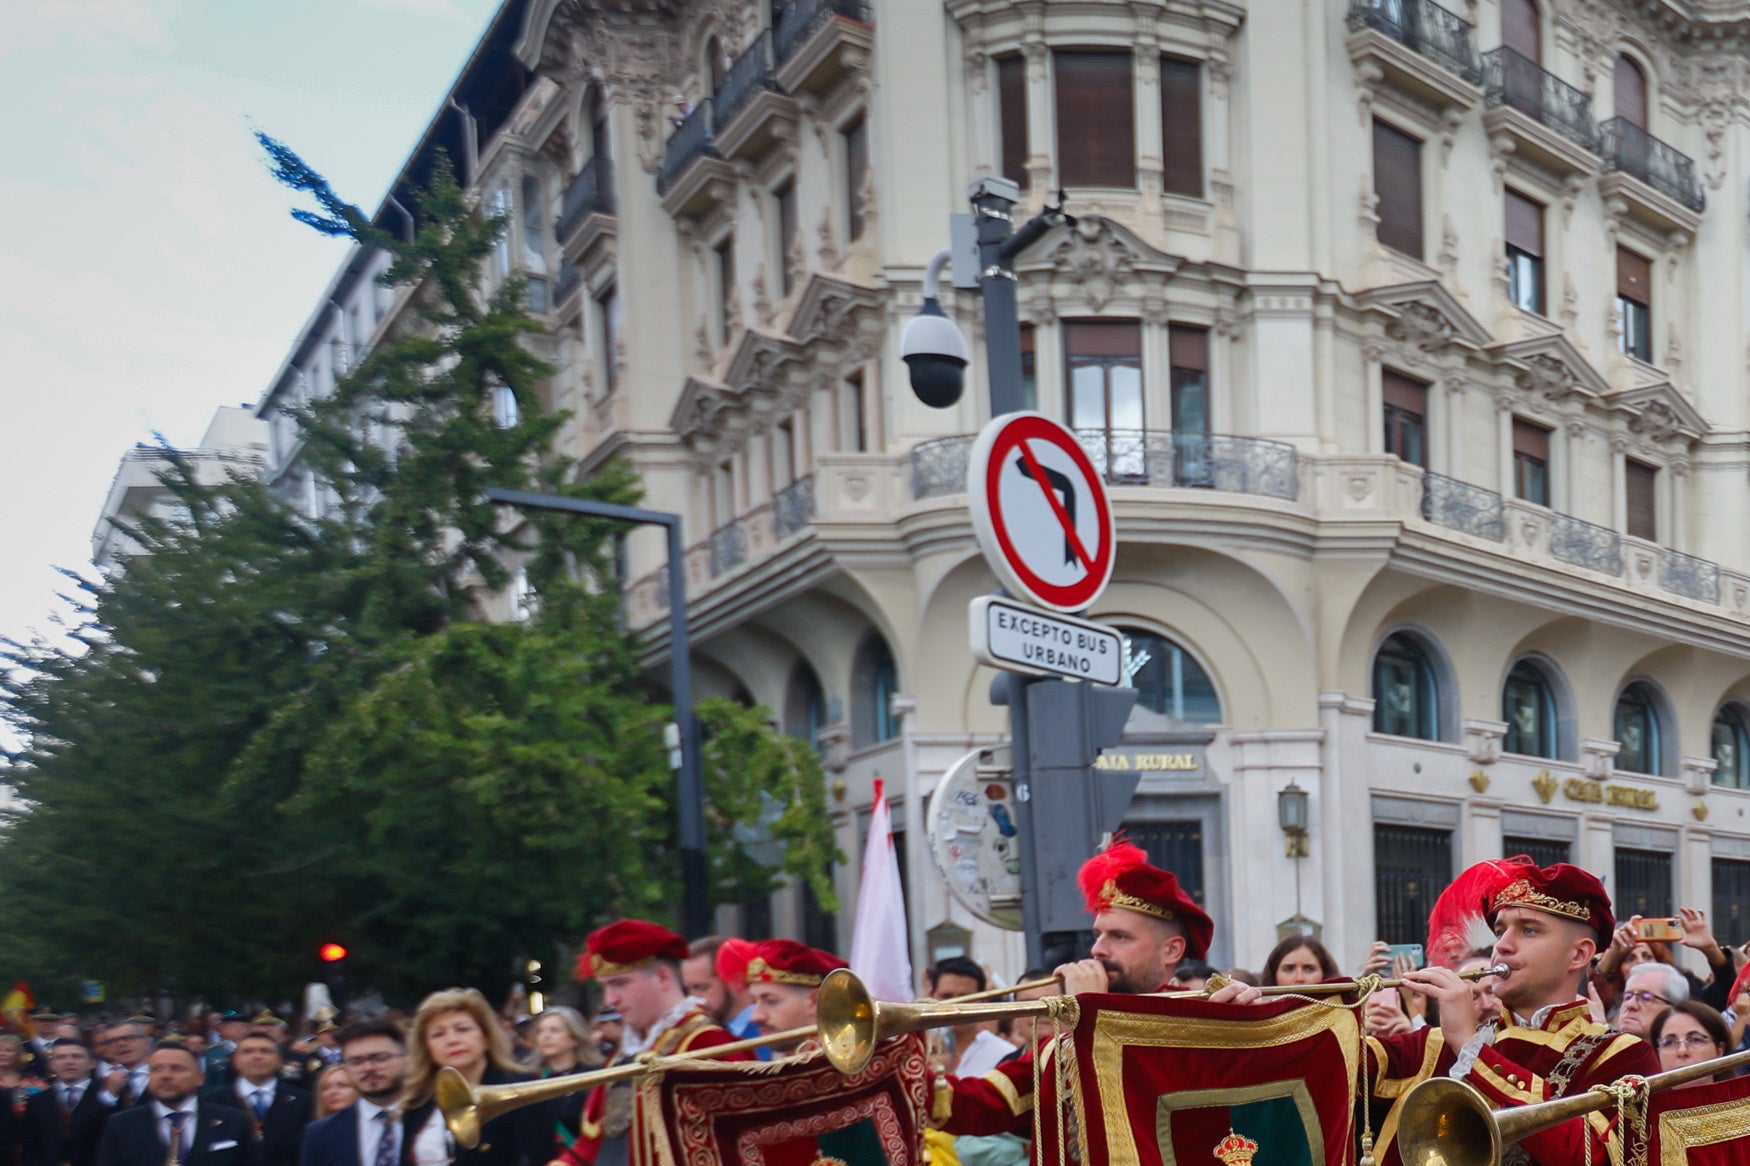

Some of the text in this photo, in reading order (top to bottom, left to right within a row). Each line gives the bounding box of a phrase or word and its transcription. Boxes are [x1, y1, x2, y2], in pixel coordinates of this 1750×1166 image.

[998, 612, 1107, 654] EXCEPTO BUS
[1023, 643, 1091, 673] URBANO
[1093, 754, 1199, 771] AJA RURAL
